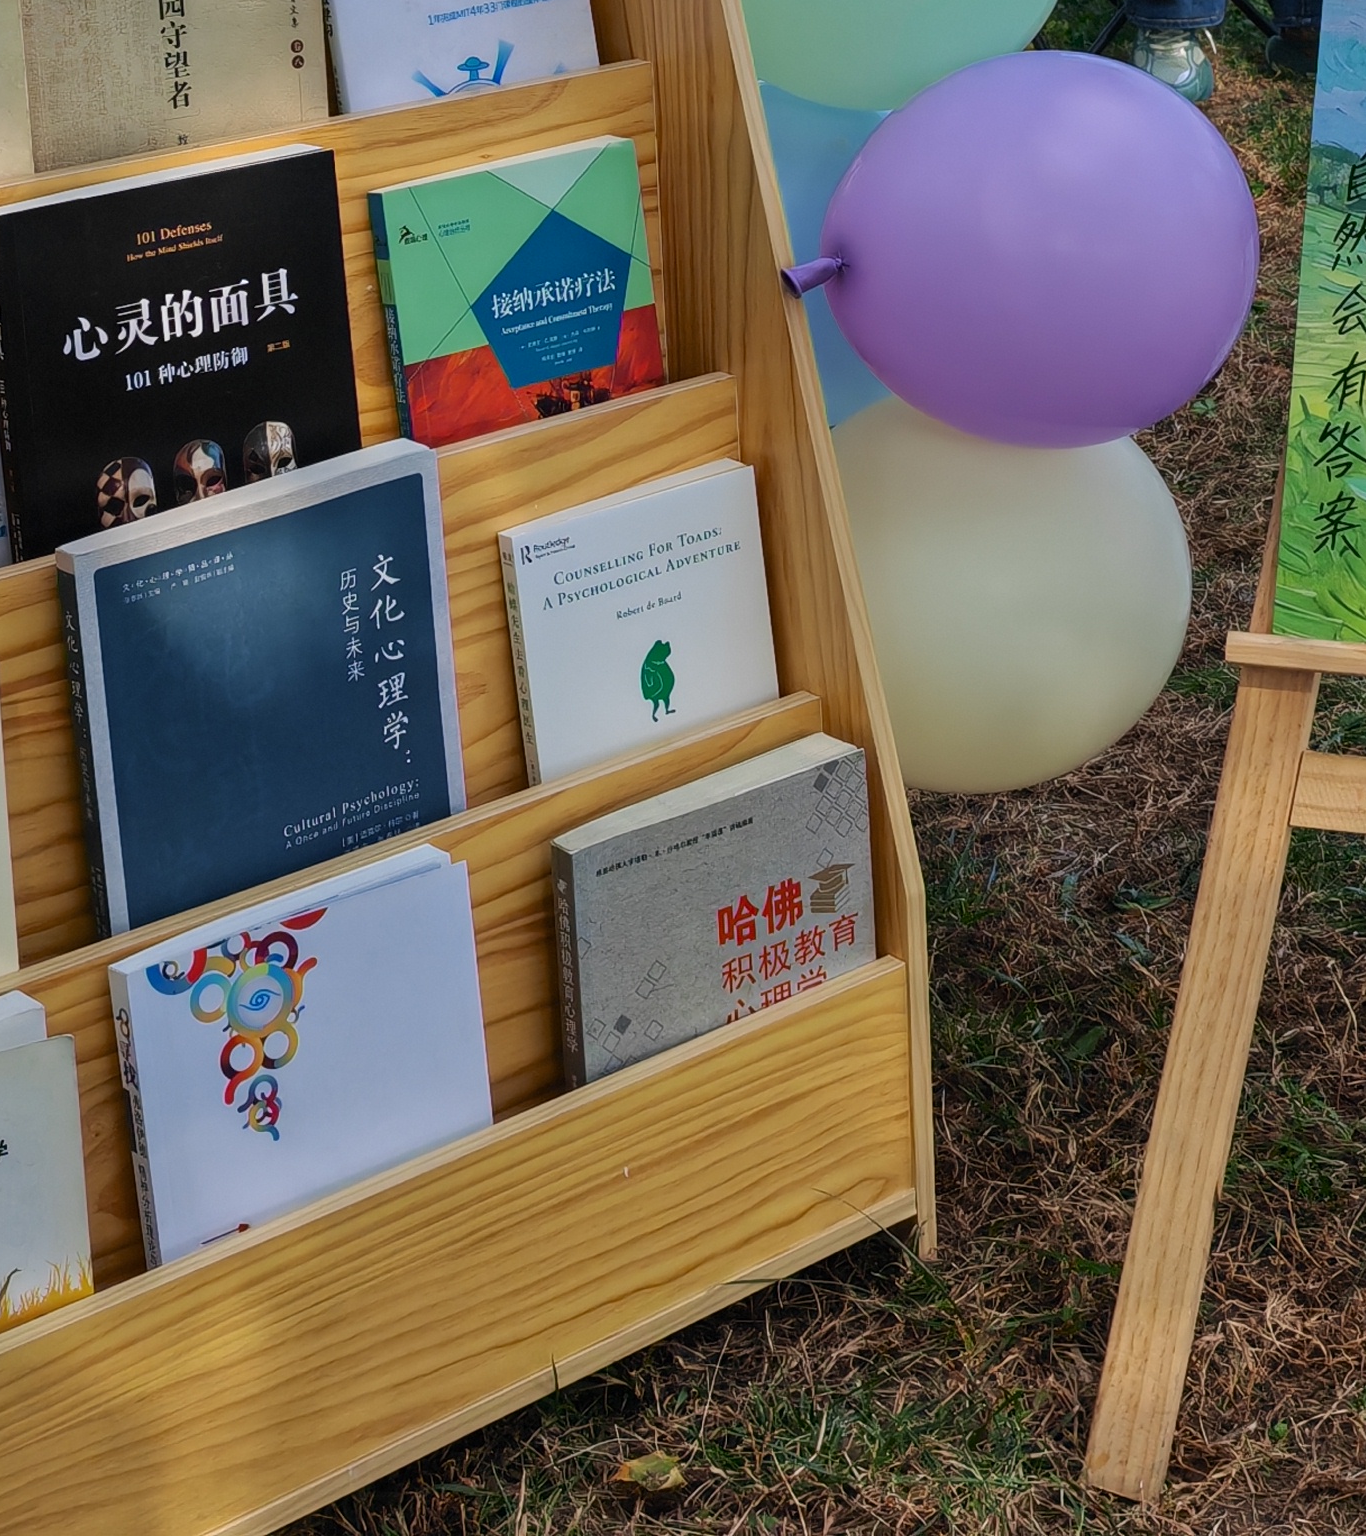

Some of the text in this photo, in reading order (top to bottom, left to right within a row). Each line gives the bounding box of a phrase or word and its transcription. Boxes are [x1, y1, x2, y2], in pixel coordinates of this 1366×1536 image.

[137, 220, 212, 246] 101 Defenses
[62, 266, 299, 362] 心灵的面具
[491, 267, 616, 319] 接纳承诺疗法
[125, 369, 150, 392] 101
[158, 345, 249, 384] 种心理防御
[542, 540, 742, 611] A PSYCHOLOGICAL ADVENTURE
[616, 590, 683, 620] Robert de Board
[339, 567, 366, 683] 历史与未来
[284, 805, 337, 838] Cultural
[342, 778, 420, 815] Psychology:
[295, 830, 319, 845] Once
[322, 821, 339, 835] and
[342, 809, 371, 827] Future
[374, 792, 420, 814] Discipline
[716, 877, 804, 946] 哈佛
[722, 910, 860, 995] 积极教育
